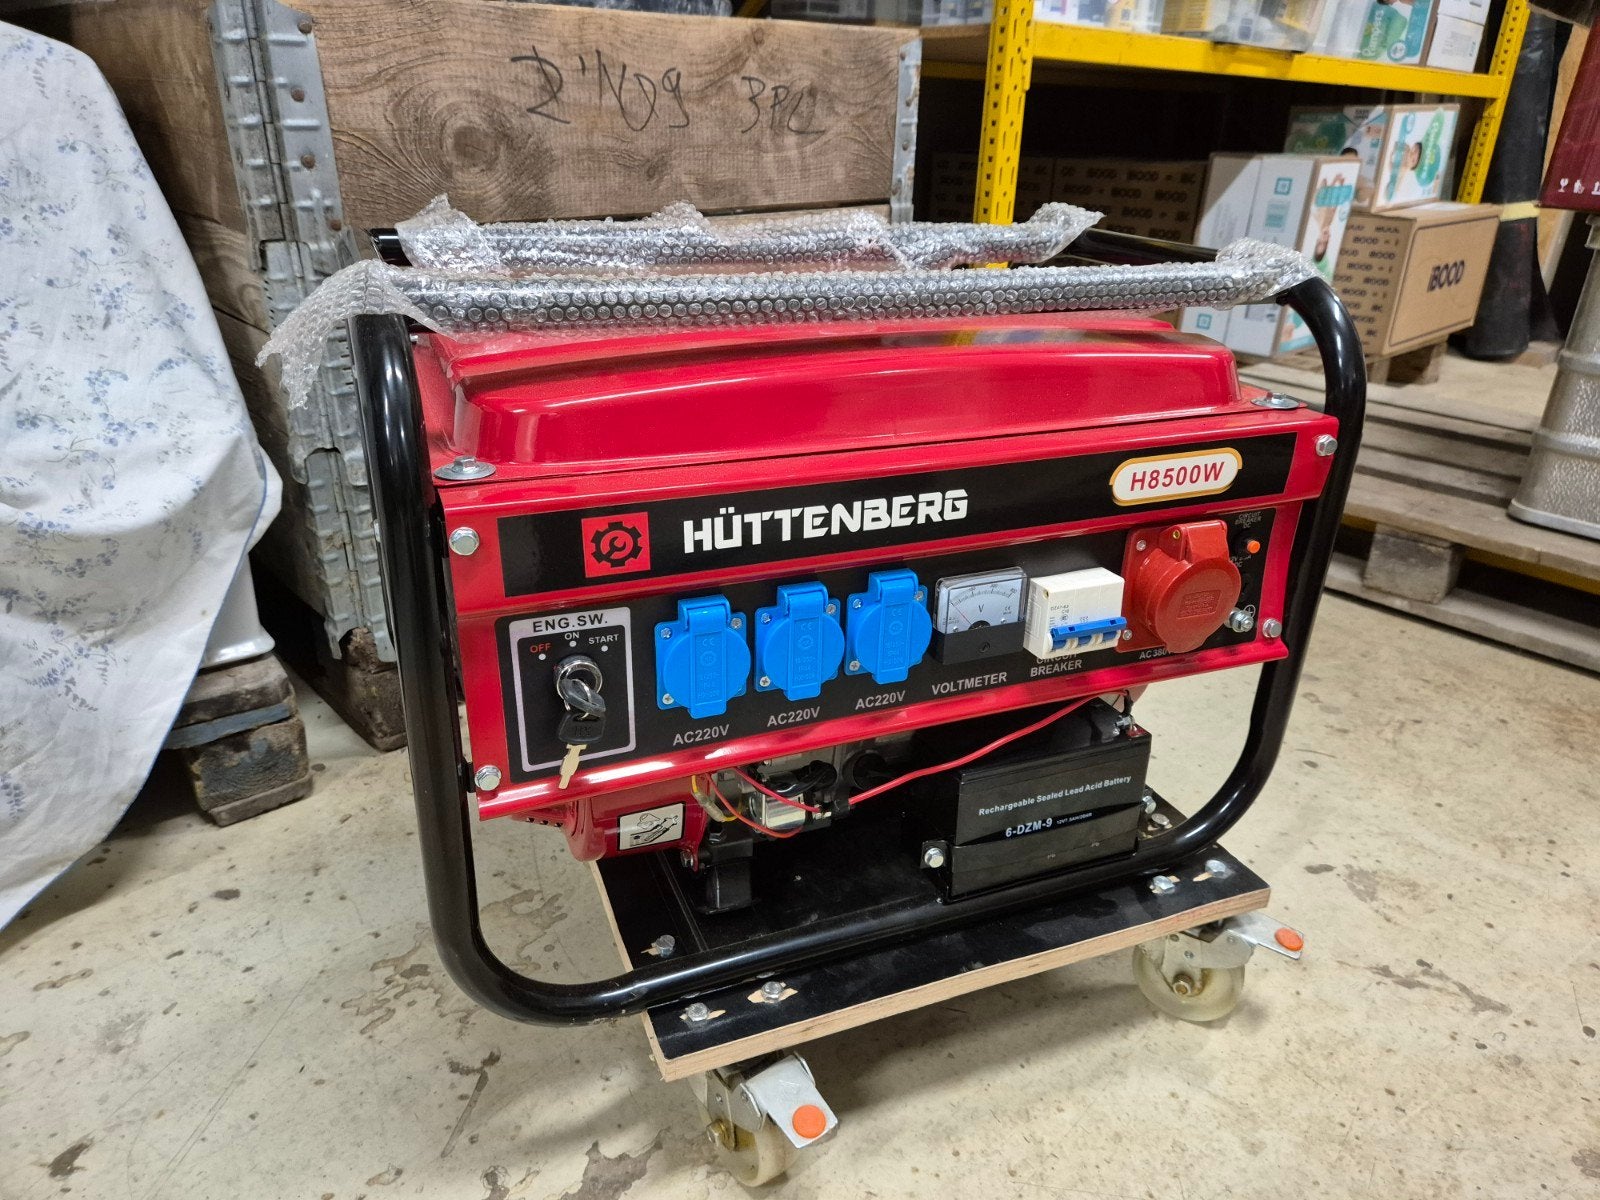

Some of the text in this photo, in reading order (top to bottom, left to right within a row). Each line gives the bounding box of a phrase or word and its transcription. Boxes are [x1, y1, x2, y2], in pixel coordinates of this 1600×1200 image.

[1130, 461, 1225, 492] H8500W
[682, 488, 969, 553] HÜTTENBERG
[533, 613, 608, 633] ENG.SW.
[564, 631, 580, 641] ON
[588, 633, 619, 645] START
[530, 643, 551, 653] OFF
[1030, 659, 1083, 678] BREAKER
[931, 671, 1008, 696] VOLTMETER
[854, 690, 906, 711] AC220V
[767, 706, 821, 728] AC220V
[672, 724, 730, 746] AC220V
[978, 775, 1132, 817] Rechargeable Sealed Lead Acid Battery
[1005, 817, 1053, 838] 6-DZM-9
